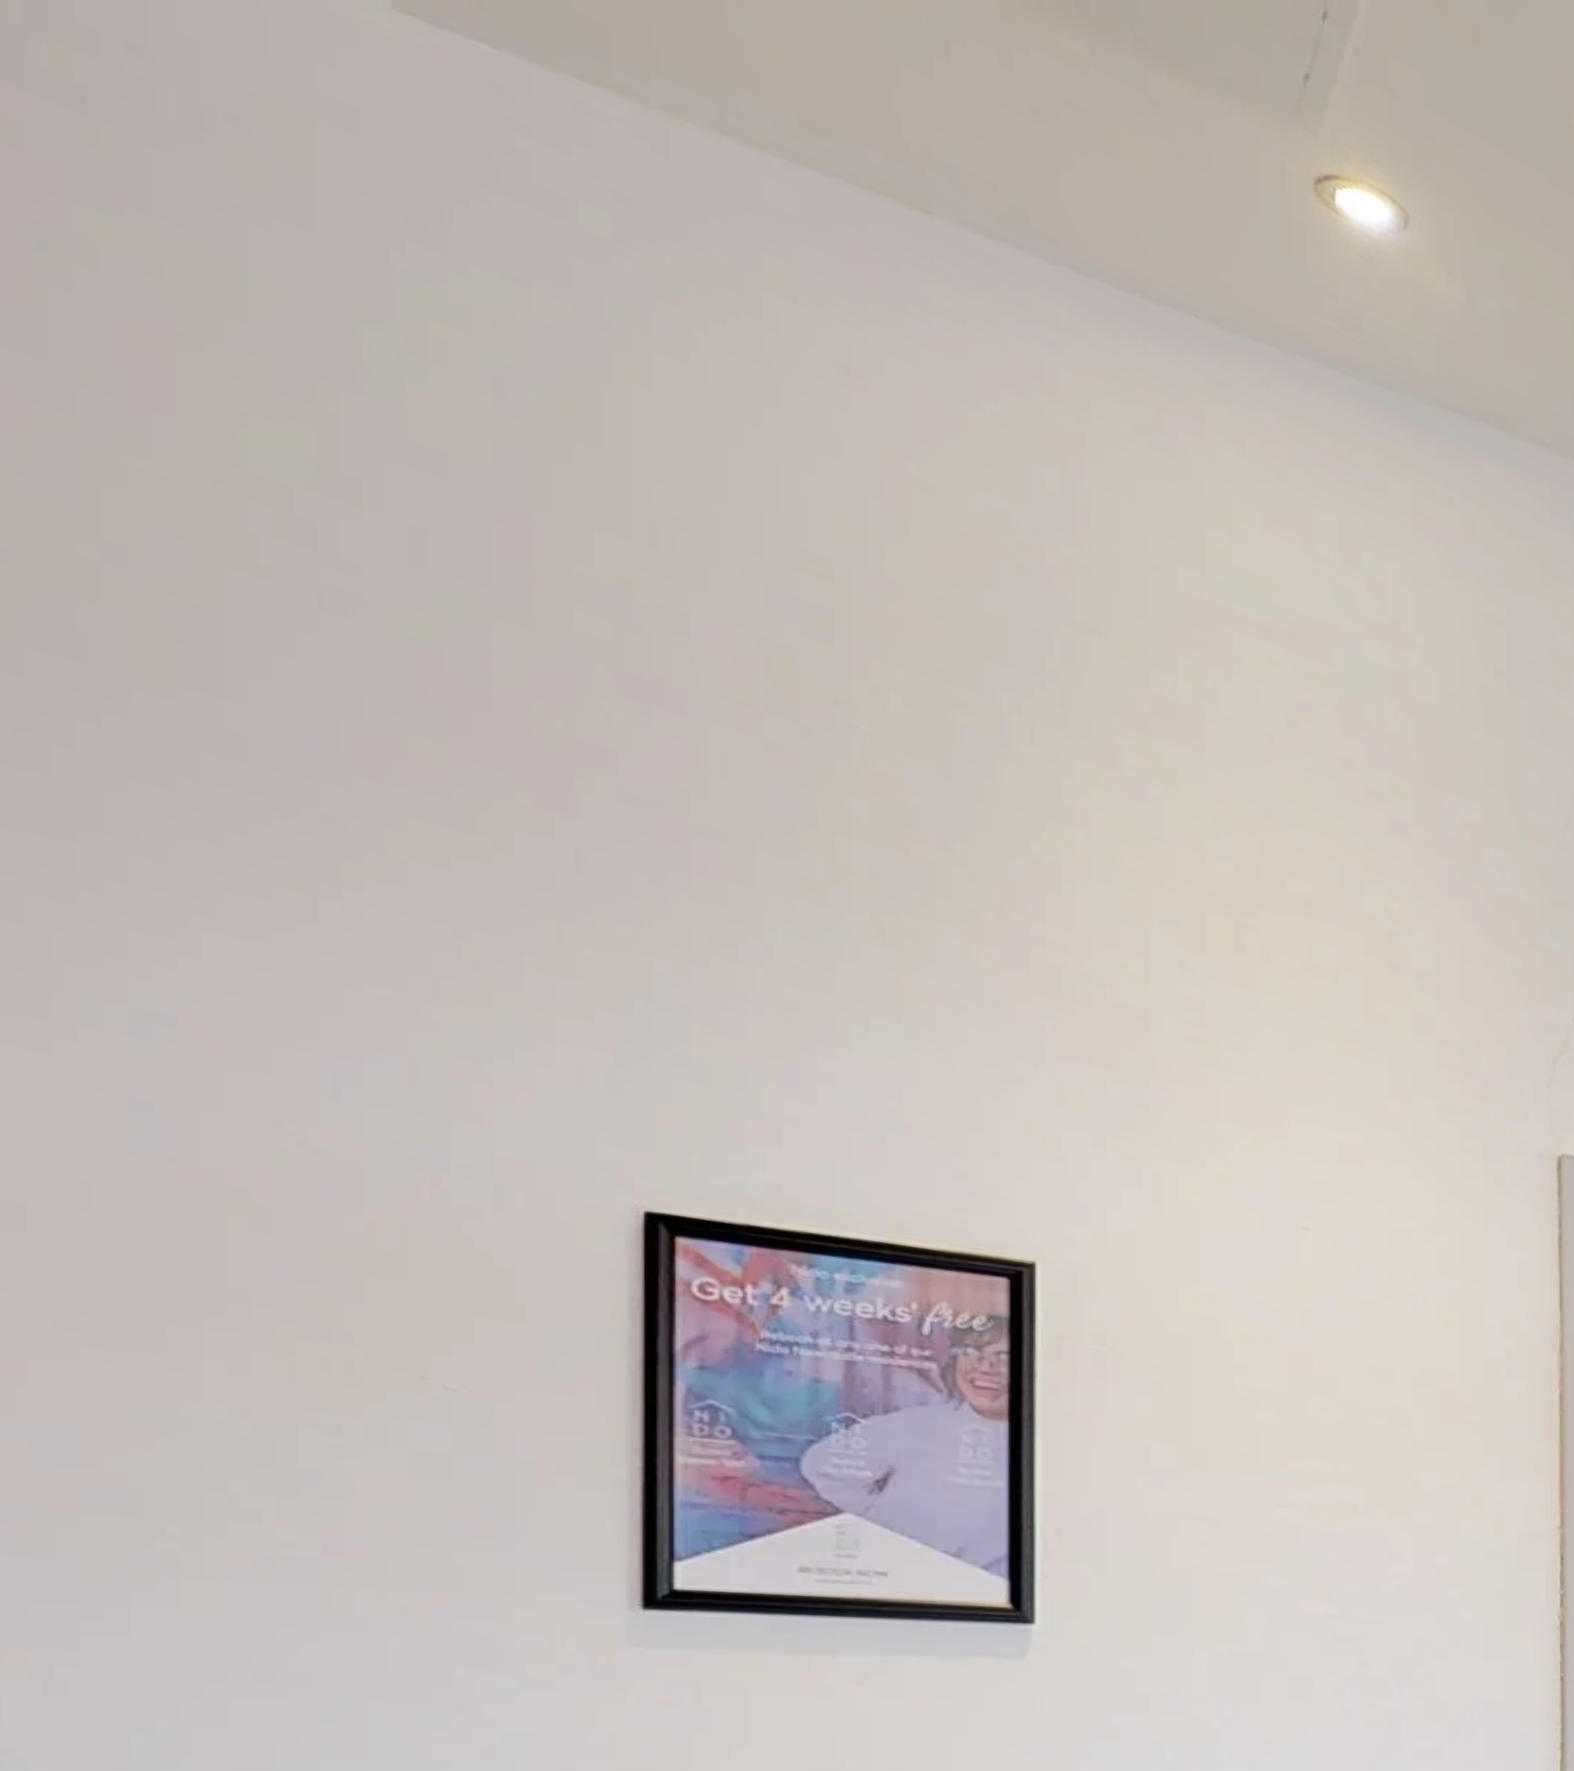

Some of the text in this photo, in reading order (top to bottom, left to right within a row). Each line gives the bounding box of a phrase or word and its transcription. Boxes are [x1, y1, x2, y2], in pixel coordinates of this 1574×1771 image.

[691, 1277, 996, 1336] Get 4 weeks' free
